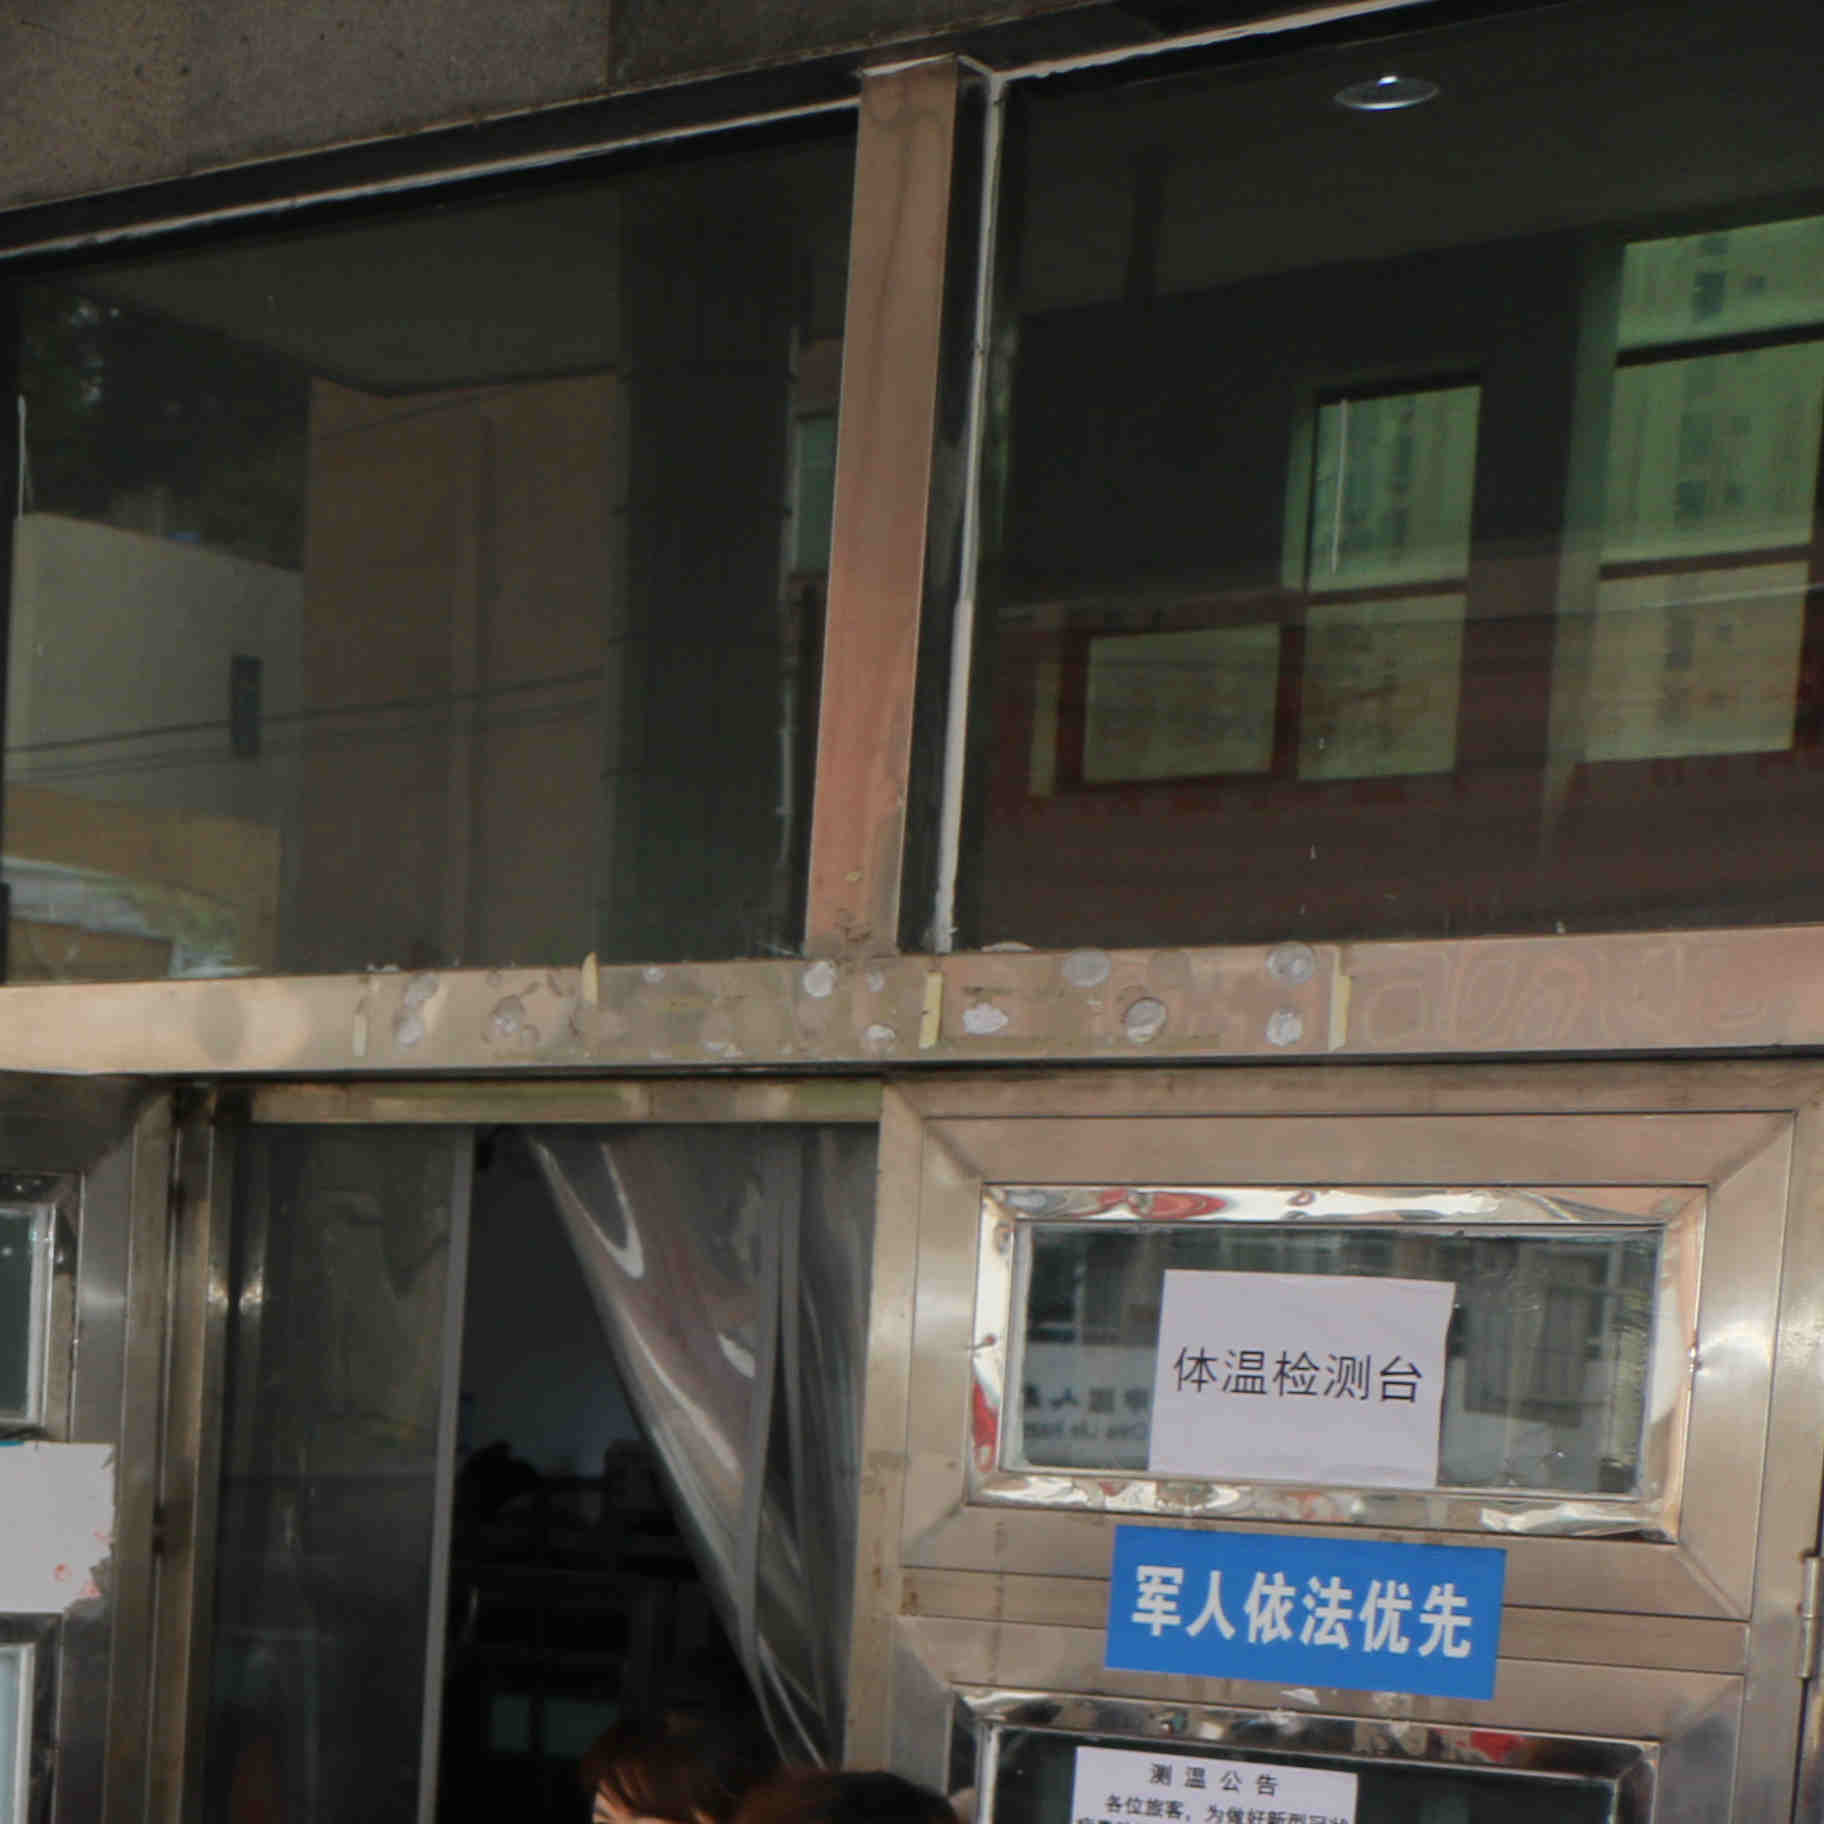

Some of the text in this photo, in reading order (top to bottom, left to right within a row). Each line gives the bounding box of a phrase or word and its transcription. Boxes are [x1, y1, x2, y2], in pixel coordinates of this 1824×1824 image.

[1173, 1346, 1423, 1403] 体温检测台
[1131, 1564, 1473, 1659] 军人依法优先
[1149, 1763, 1279, 1797] 测温公告
